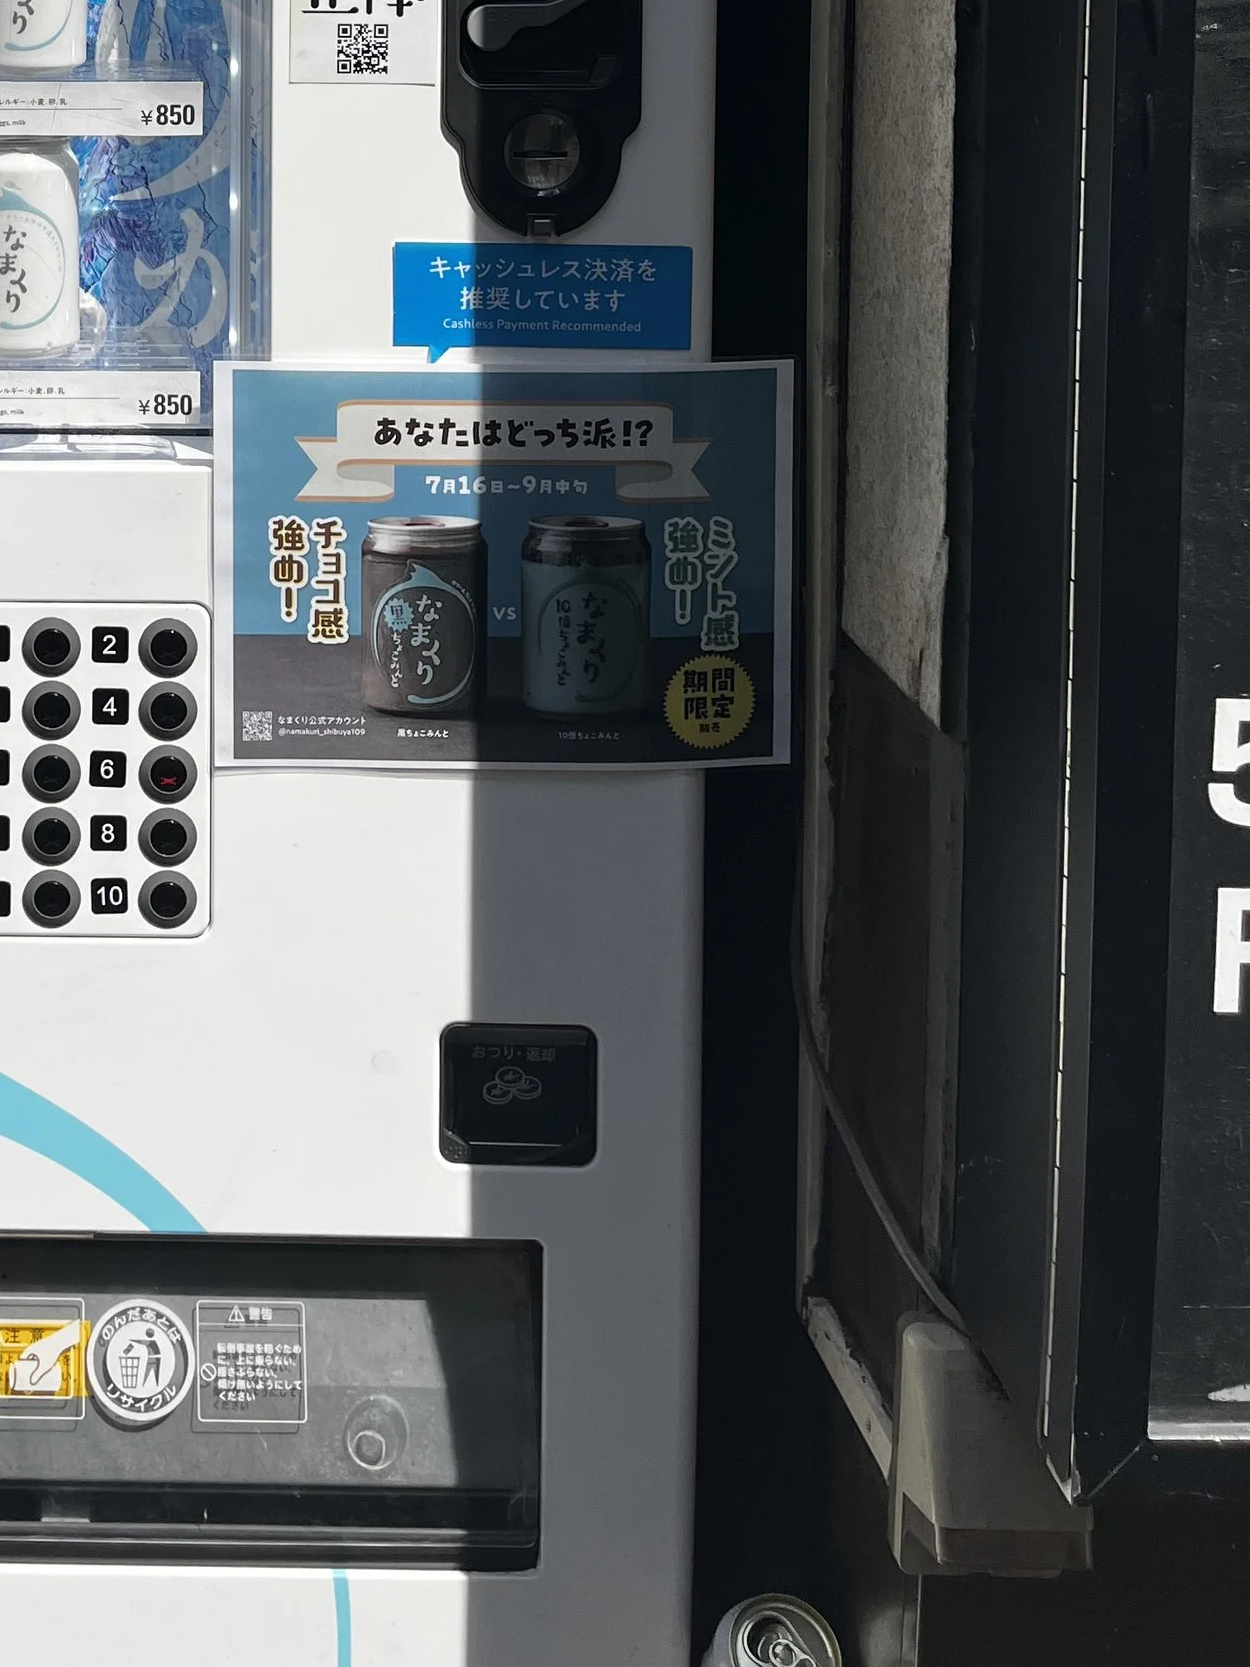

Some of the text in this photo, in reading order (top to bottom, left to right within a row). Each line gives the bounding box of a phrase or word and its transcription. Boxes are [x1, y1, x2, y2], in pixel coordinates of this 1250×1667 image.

[141, 104, 195, 126] ¥850
[429, 255, 656, 282] キャッシュレス決済を
[460, 286, 625, 312] 推奨しています
[443, 318, 642, 333] Cashless Payment Recommended
[138, 394, 192, 415] ¥850
[311, 518, 346, 641] チョコ感
[704, 519, 737, 646] ミント感
[102, 635, 117, 655] 2
[410, 594, 443, 685] なまくり
[683, 668, 736, 694] 期間
[102, 697, 117, 716] 4
[684, 695, 735, 720] 限定
[100, 759, 114, 779] 6
[101, 824, 115, 843] 8
[97, 886, 123, 906] 10
[101, 1308, 181, 1344] のんだあとは
[107, 1385, 177, 1412] リサイクル
